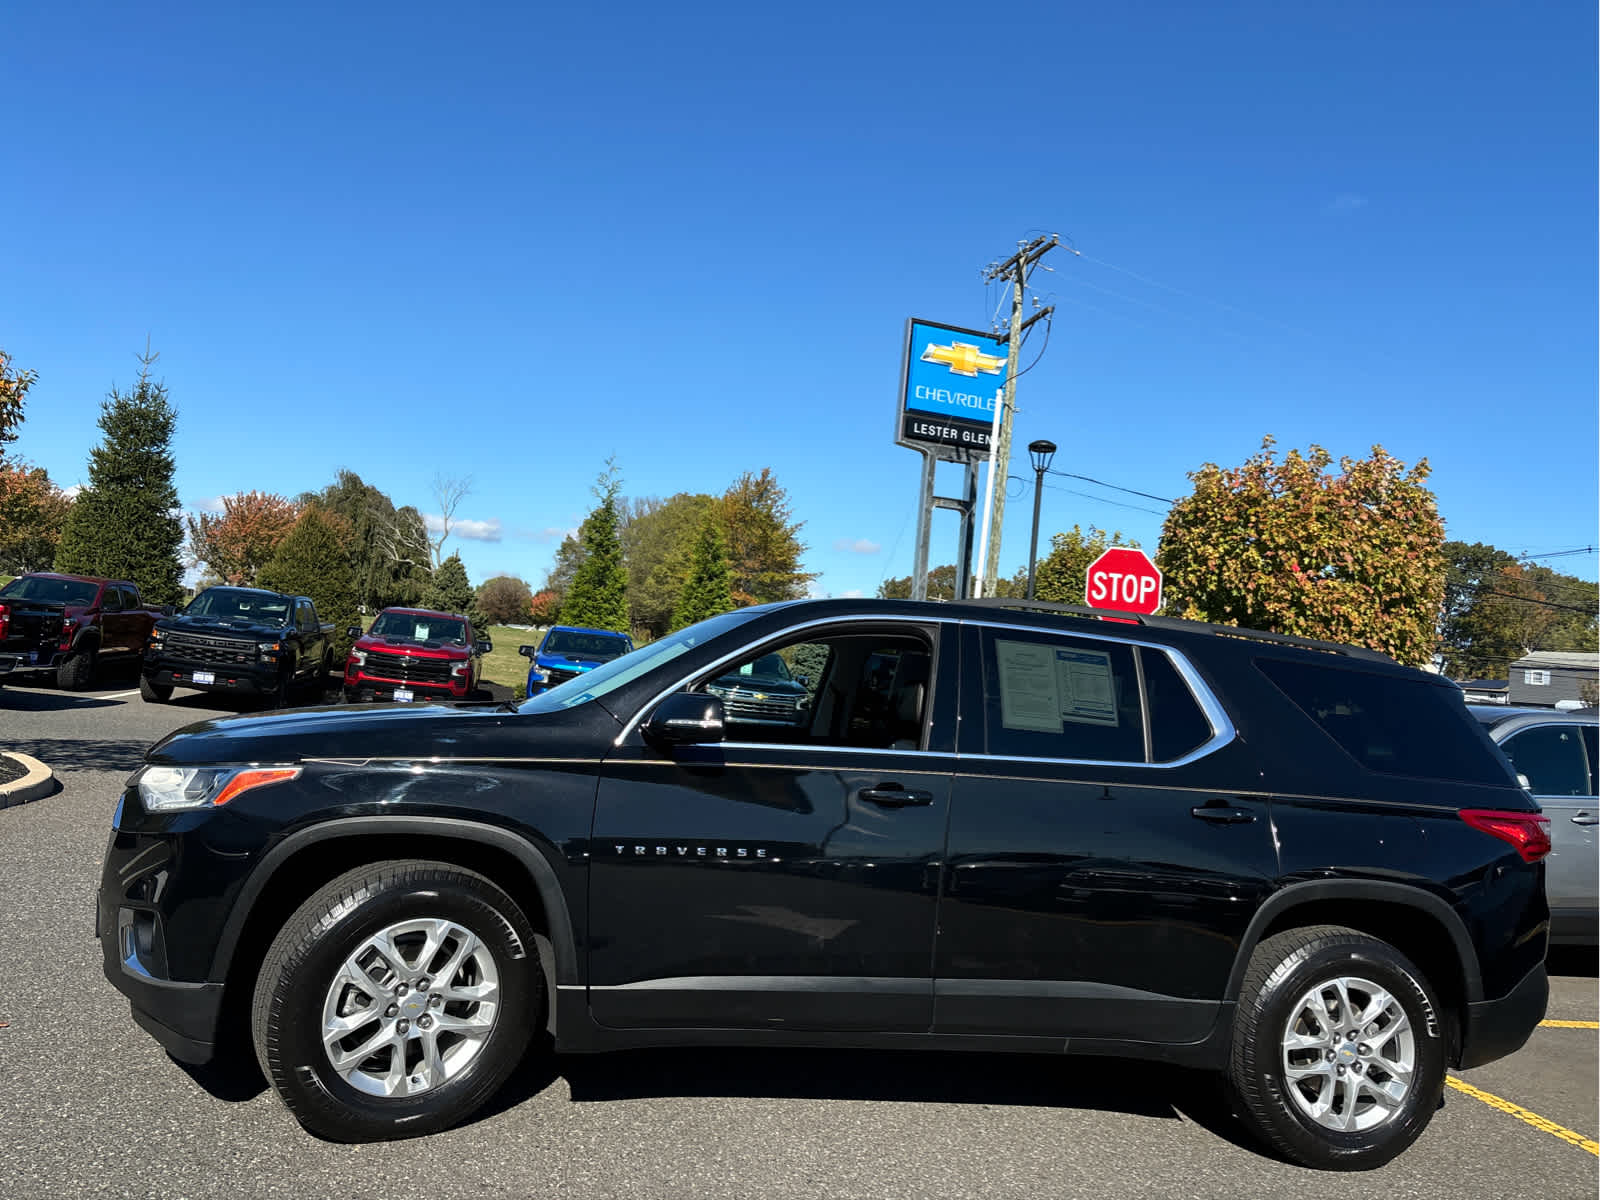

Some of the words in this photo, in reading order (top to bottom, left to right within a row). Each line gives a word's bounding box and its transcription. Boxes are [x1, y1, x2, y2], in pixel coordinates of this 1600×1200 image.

[915, 385, 996, 412] CHEVROLE
[913, 422, 958, 440] LESTER
[962, 431, 993, 445] GLEN
[1091, 571, 1156, 604] STOP
[615, 845, 767, 858] TRAVERSE
